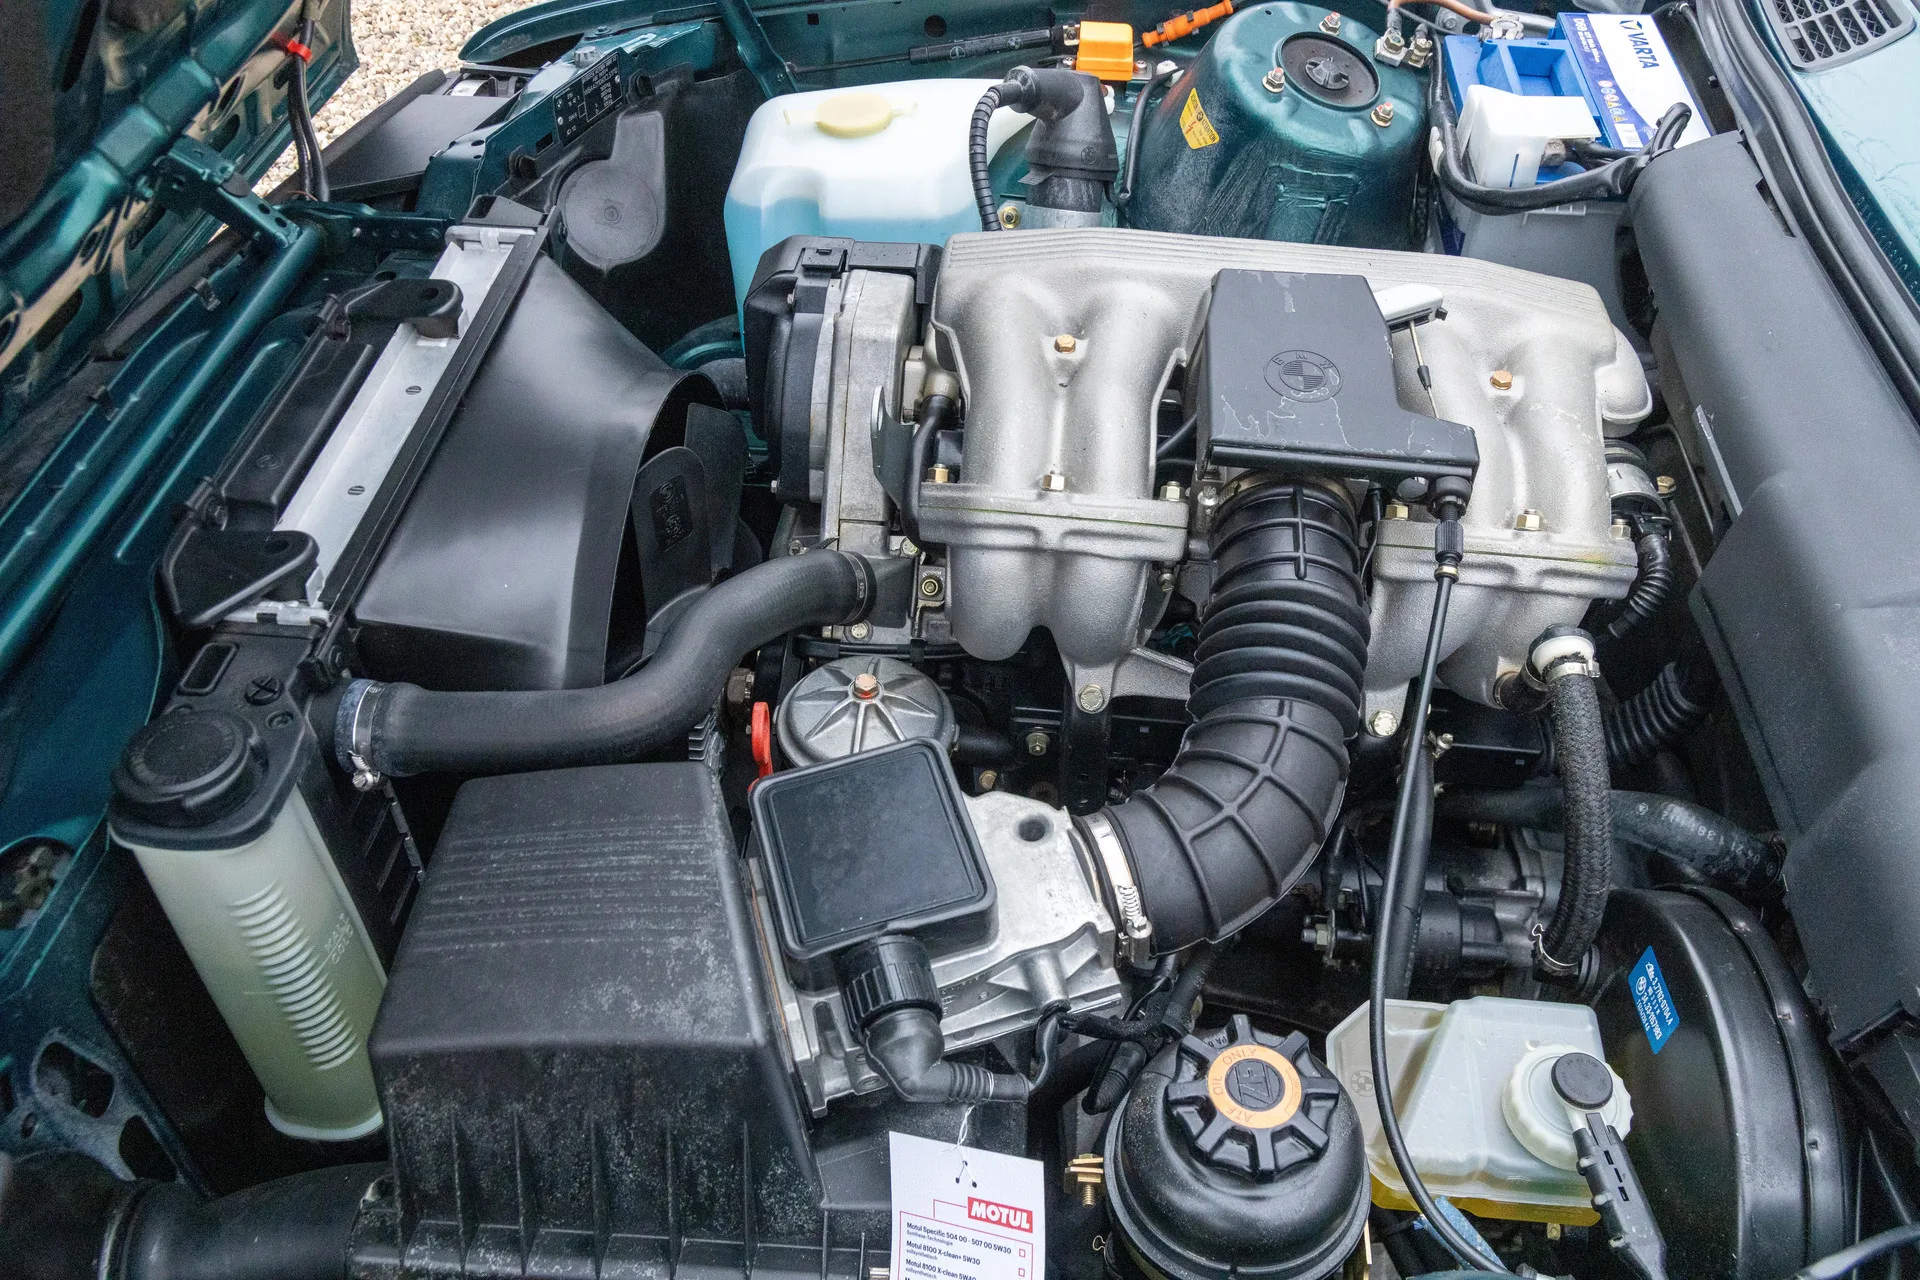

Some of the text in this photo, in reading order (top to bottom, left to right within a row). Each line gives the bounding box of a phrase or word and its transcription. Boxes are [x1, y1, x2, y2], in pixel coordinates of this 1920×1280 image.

[1628, 33, 1660, 68] VARTA
[1271, 351, 1334, 370] BMW
[1222, 1047, 1257, 1065] ONLY
[1213, 1076, 1223, 1095] OIL
[1226, 1107, 1253, 1122] ATF
[970, 1201, 1030, 1229] MOTUL
[906, 1222, 922, 1231] Motul
[923, 1226, 945, 1239] Specific
[946, 1232, 957, 1241] 504
[958, 1235, 967, 1243] 00
[971, 1238, 983, 1247] 507
[993, 1244, 1012, 1254] 5W30
[906, 1240, 922, 1250] Motul
[923, 1245, 937, 1254] 8100
[962, 1255, 981, 1266] 5W30
[905, 1259, 921, 1268] Motul
[922, 1263, 936, 1272] 8100
[937, 1267, 959, 1278] X-clean
